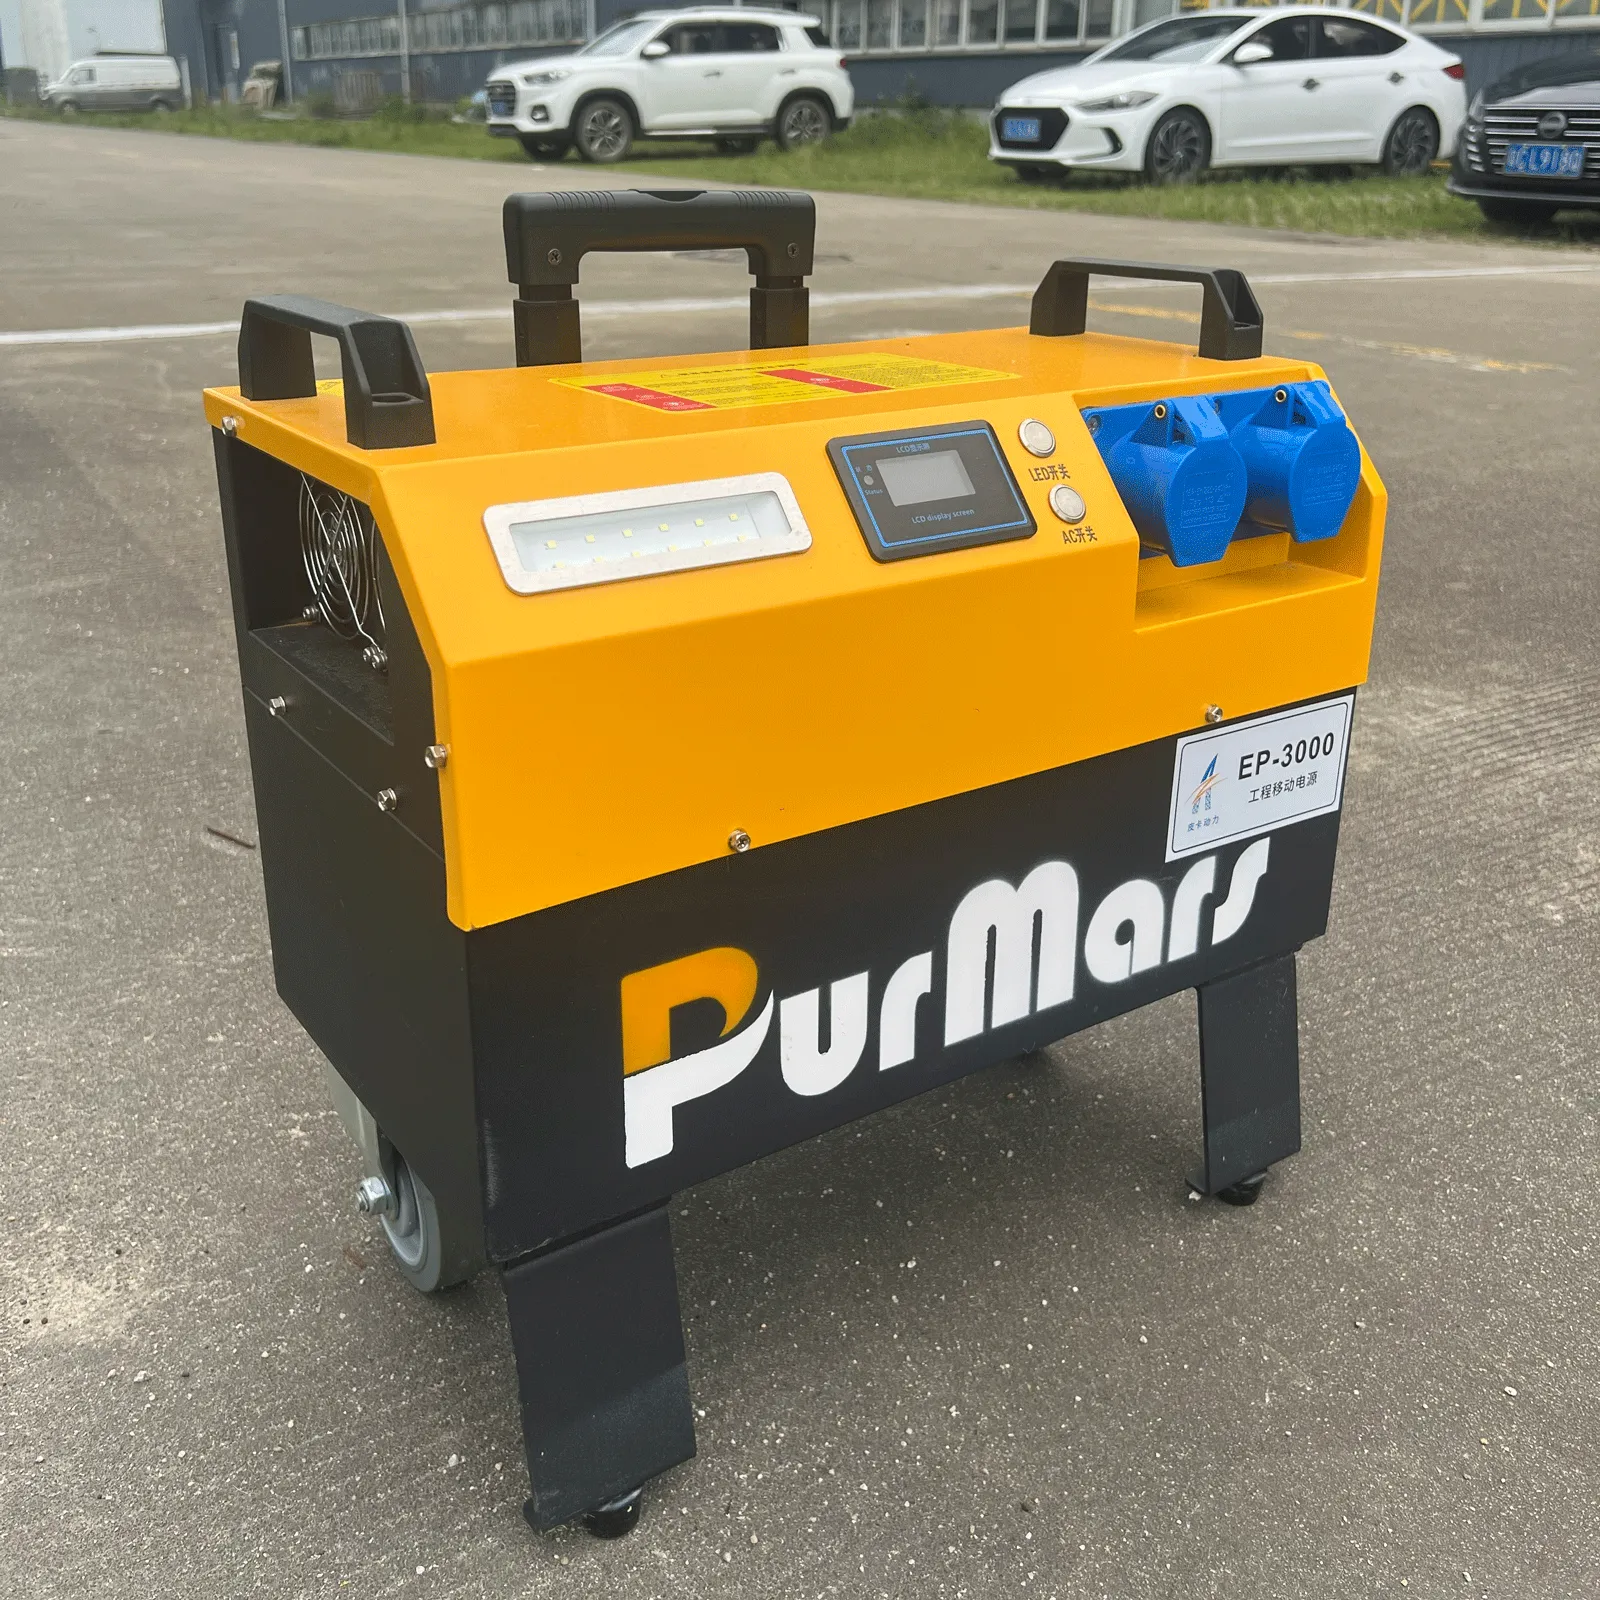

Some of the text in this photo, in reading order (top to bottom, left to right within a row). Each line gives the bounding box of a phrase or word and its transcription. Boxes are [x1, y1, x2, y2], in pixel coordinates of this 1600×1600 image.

[1028, 463, 1071, 482] LED开关
[864, 488, 884, 496] Status
[911, 508, 975, 524] LCD display screen
[1062, 526, 1098, 545] AC开关
[1238, 732, 1335, 780] EP-3000
[1248, 771, 1318, 803] 工程移动电源
[620, 836, 1270, 1169] PurMars
